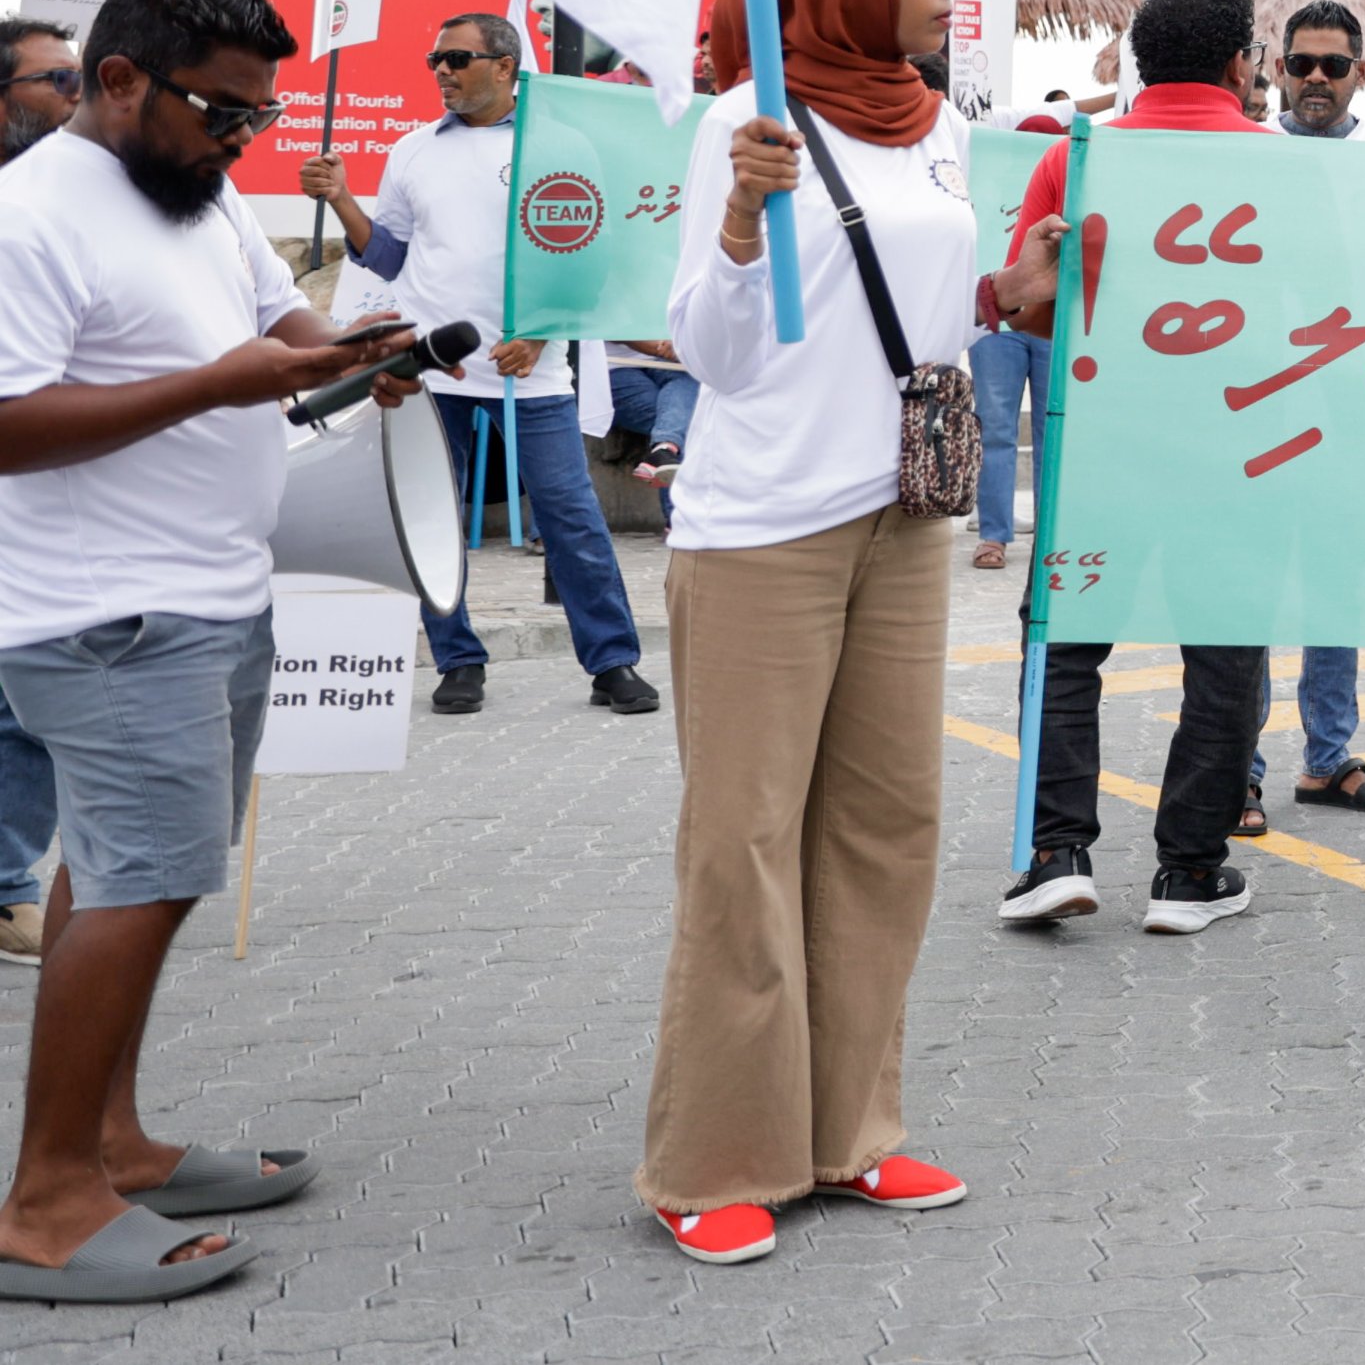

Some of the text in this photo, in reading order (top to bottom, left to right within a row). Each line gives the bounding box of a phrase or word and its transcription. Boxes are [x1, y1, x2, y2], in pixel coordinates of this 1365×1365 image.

[278, 91, 404, 109] Officil Tourist
[277, 115, 377, 131] Destiation
[532, 205, 593, 222] TEAM
[274, 655, 405, 677] ion Right
[318, 688, 396, 711] Right
